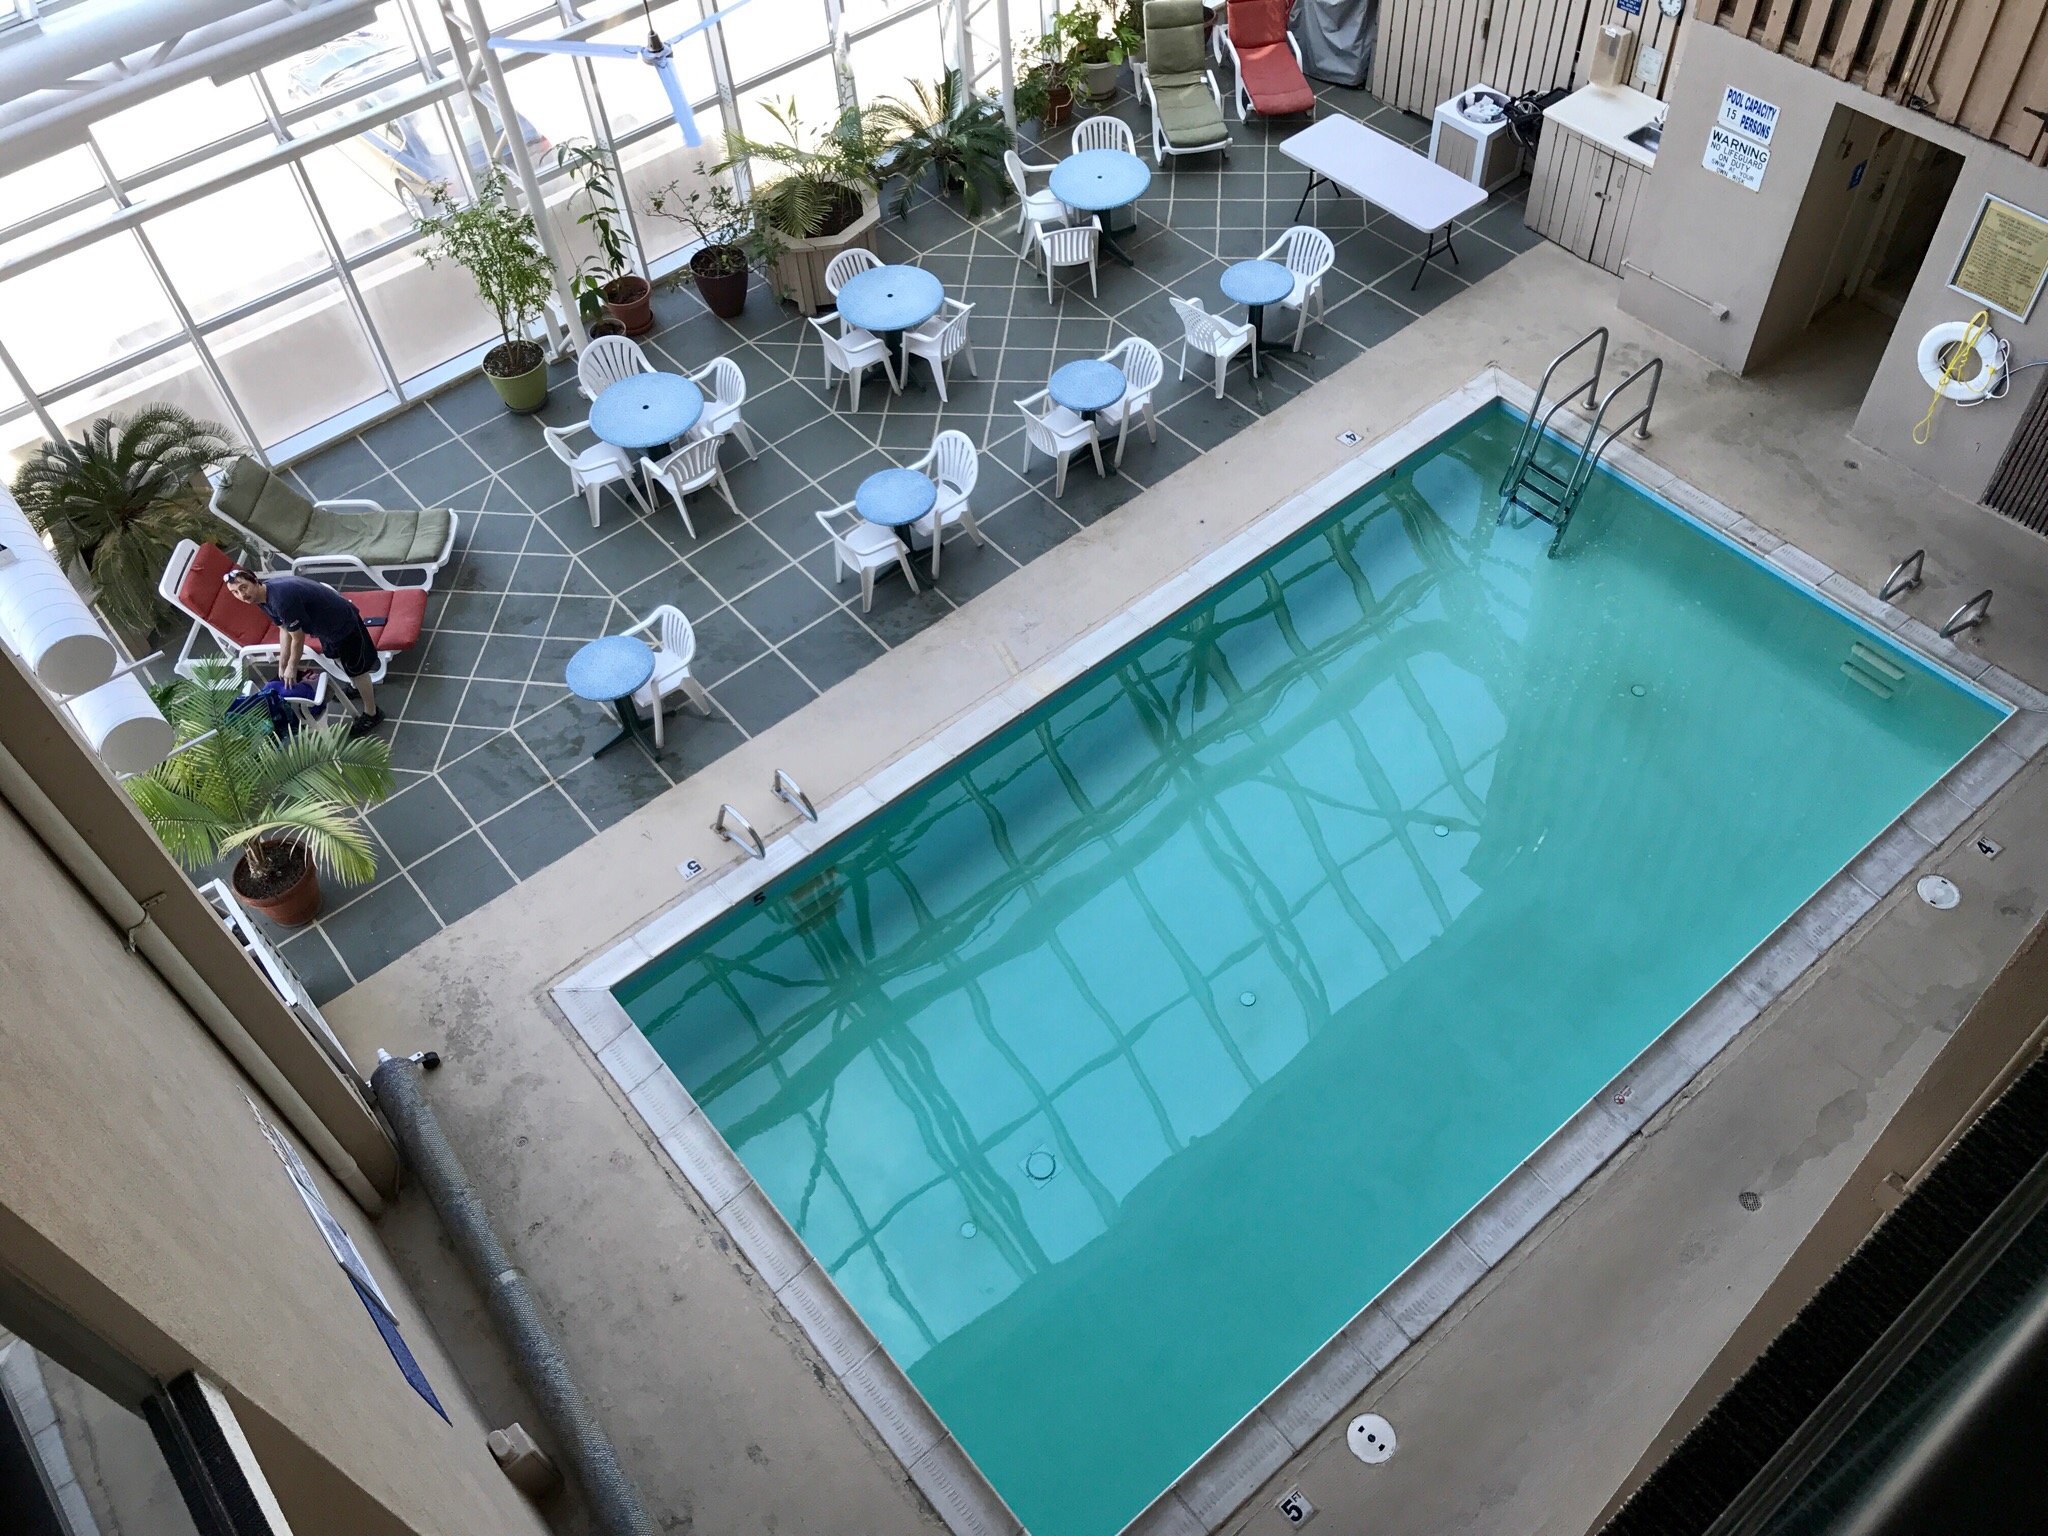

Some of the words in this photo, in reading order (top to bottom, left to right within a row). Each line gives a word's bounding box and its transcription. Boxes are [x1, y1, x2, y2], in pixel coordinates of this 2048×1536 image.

[1726, 88, 1744, 107] POOL
[1744, 97, 1777, 122] CAPACITY
[1726, 107, 1738, 120] 15
[1739, 114, 1771, 139] PERSONS
[1710, 141, 1721, 151] NO
[1723, 147, 1763, 170] LIFEGUARD
[1712, 129, 1768, 163] WARNING
[1711, 158, 1726, 168] SWIM
[1728, 165, 1736, 173] AT
[1739, 171, 1755, 182] YOUR
[1718, 153, 1729, 164] ON
[1731, 159, 1751, 173] DUTY
[1716, 167, 1728, 178] OWN
[1731, 175, 1746, 184] RISK
[1346, 433, 1357, 442] 4
[1976, 840, 1994, 855] 4
[687, 860, 702, 874] 5
[753, 892, 767, 907] 5
[1290, 1490, 1302, 1503] FT
[1280, 1498, 1303, 1522] 5
